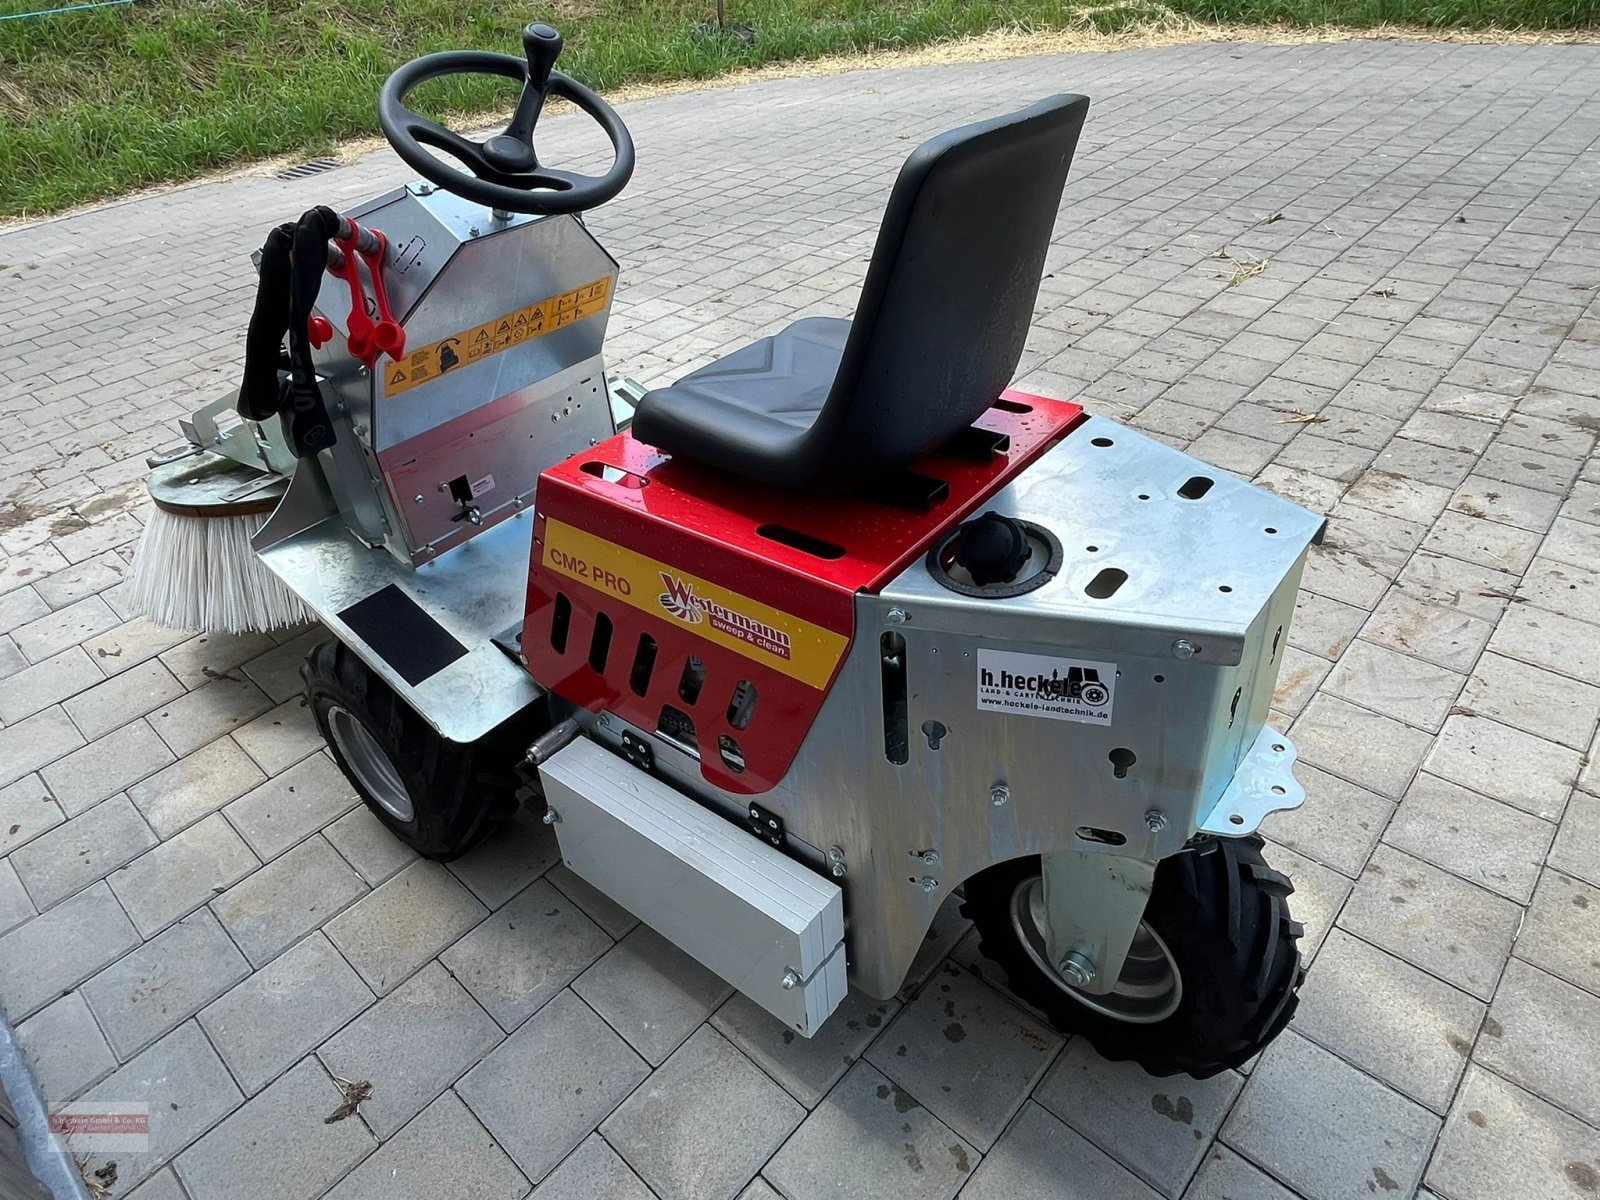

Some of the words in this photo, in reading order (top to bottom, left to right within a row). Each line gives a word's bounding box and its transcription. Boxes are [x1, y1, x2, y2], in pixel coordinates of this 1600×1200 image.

[550, 548, 588, 578] CM2
[592, 565, 632, 596] PRO
[659, 570, 790, 648] Westermann
[712, 619, 746, 638] sweep
[747, 632, 754, 643] &
[756, 637, 788, 657] clean.
[981, 667, 1082, 698] h.heckele
[981, 697, 1109, 719] www.heckele-landtechnik.de
